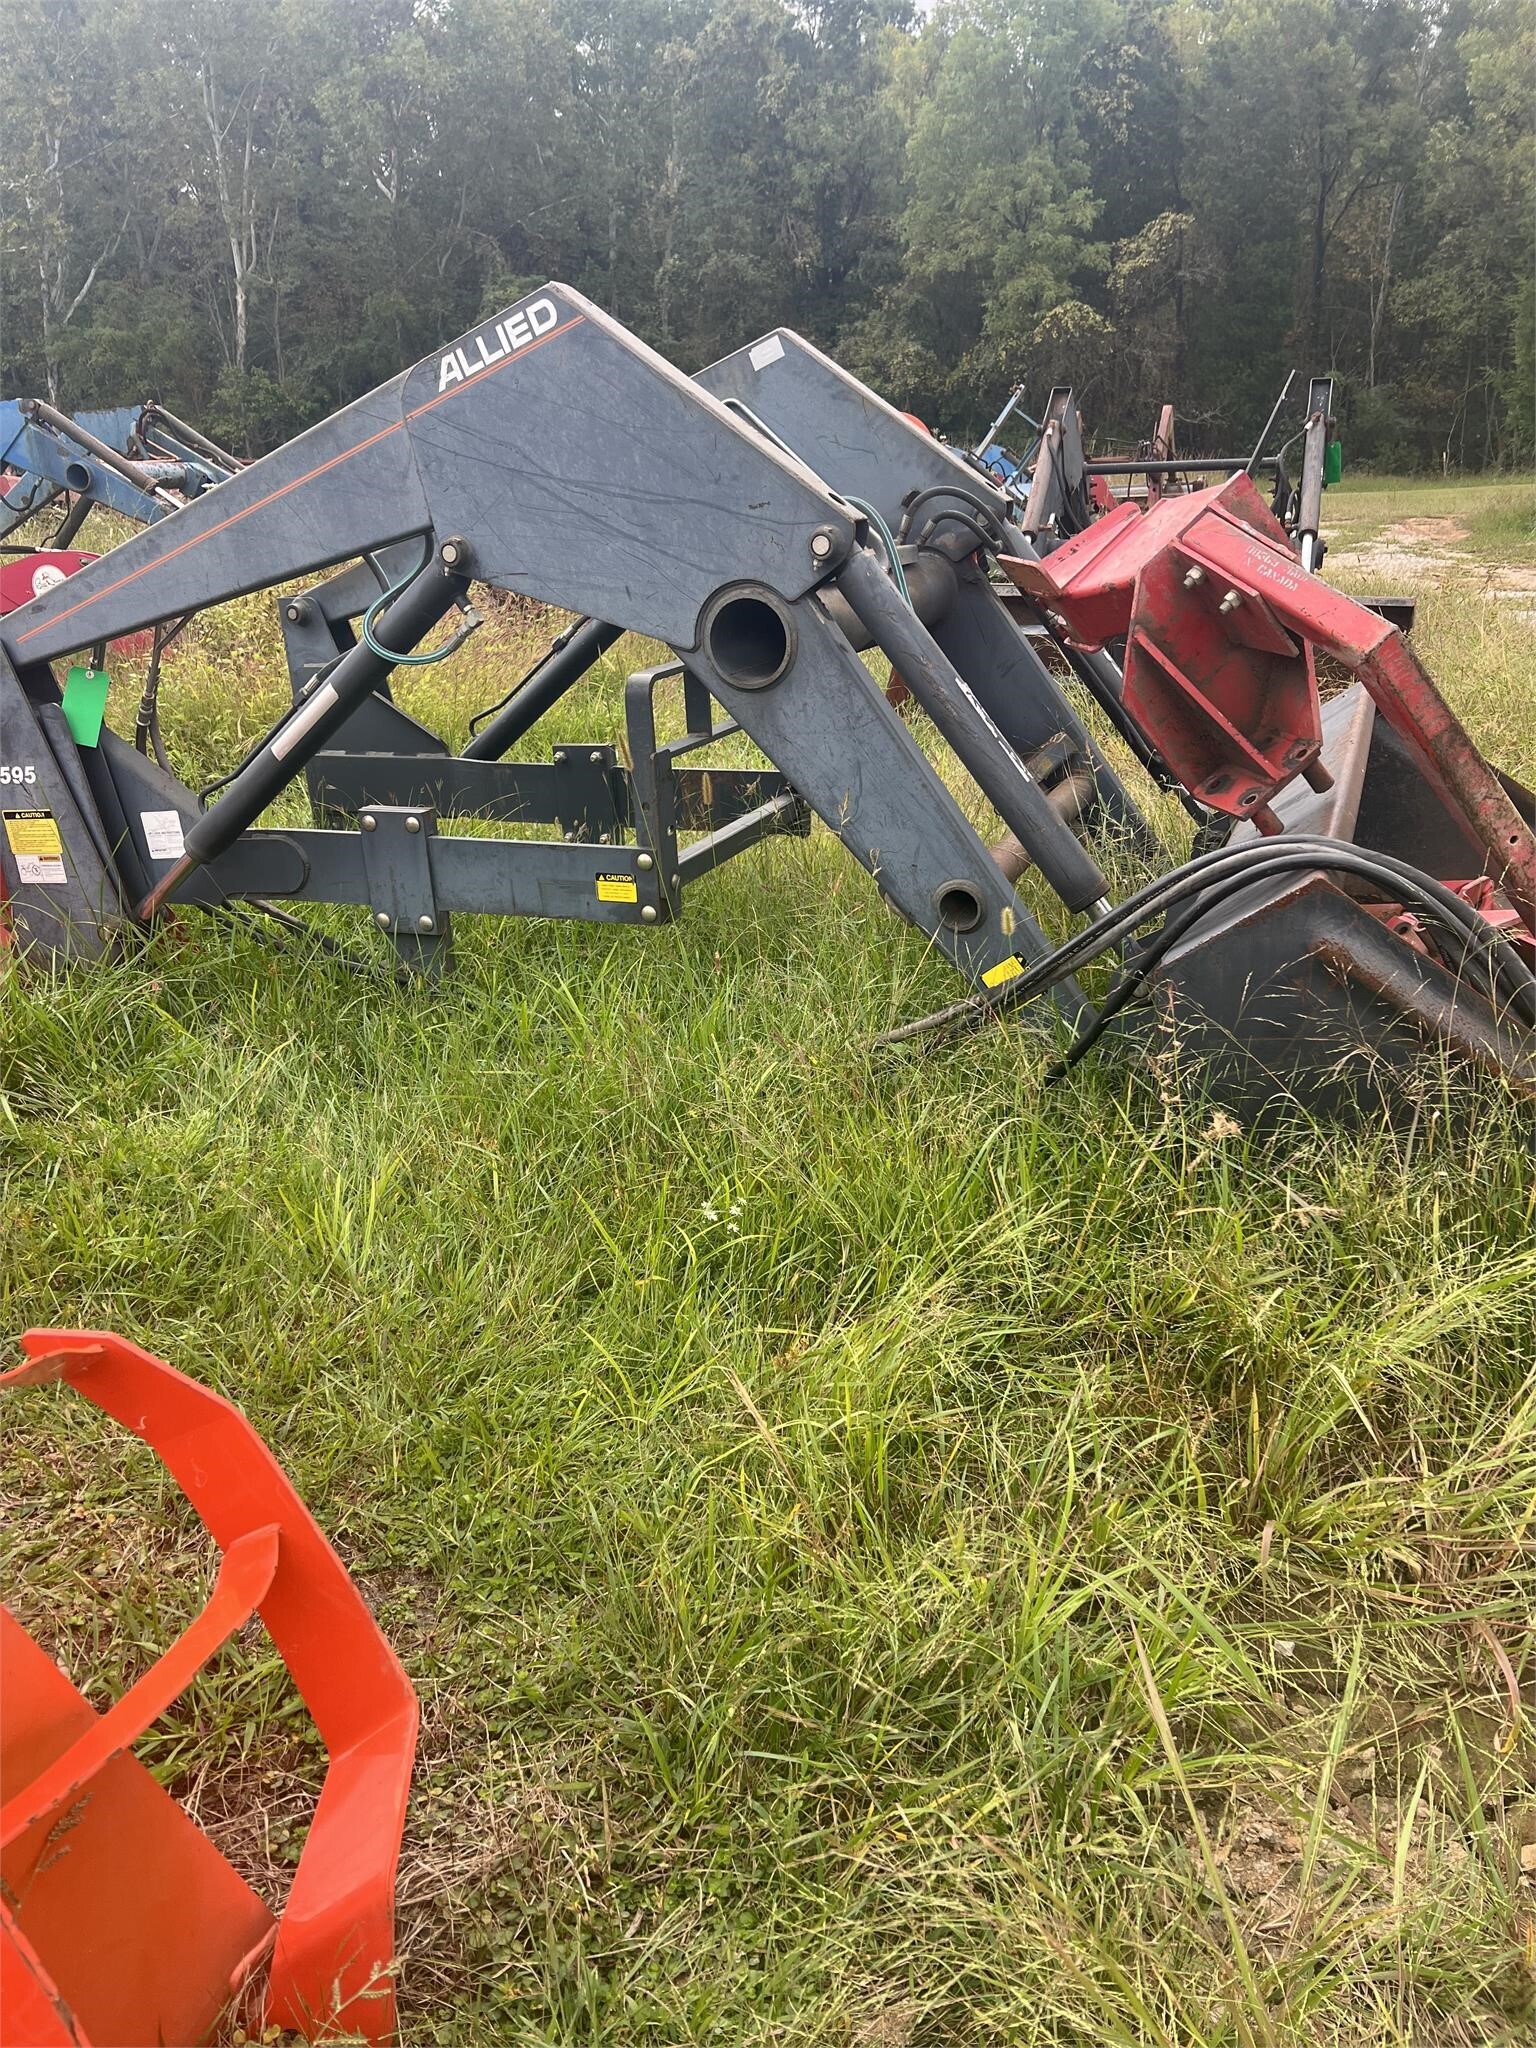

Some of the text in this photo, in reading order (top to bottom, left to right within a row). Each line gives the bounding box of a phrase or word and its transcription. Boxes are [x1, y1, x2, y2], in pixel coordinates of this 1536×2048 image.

[439, 298, 557, 392] ALLIED
[1256, 563, 1298, 592] CANADA
[0, 766, 36, 784] 595
[606, 874, 632, 882] CAUTION
